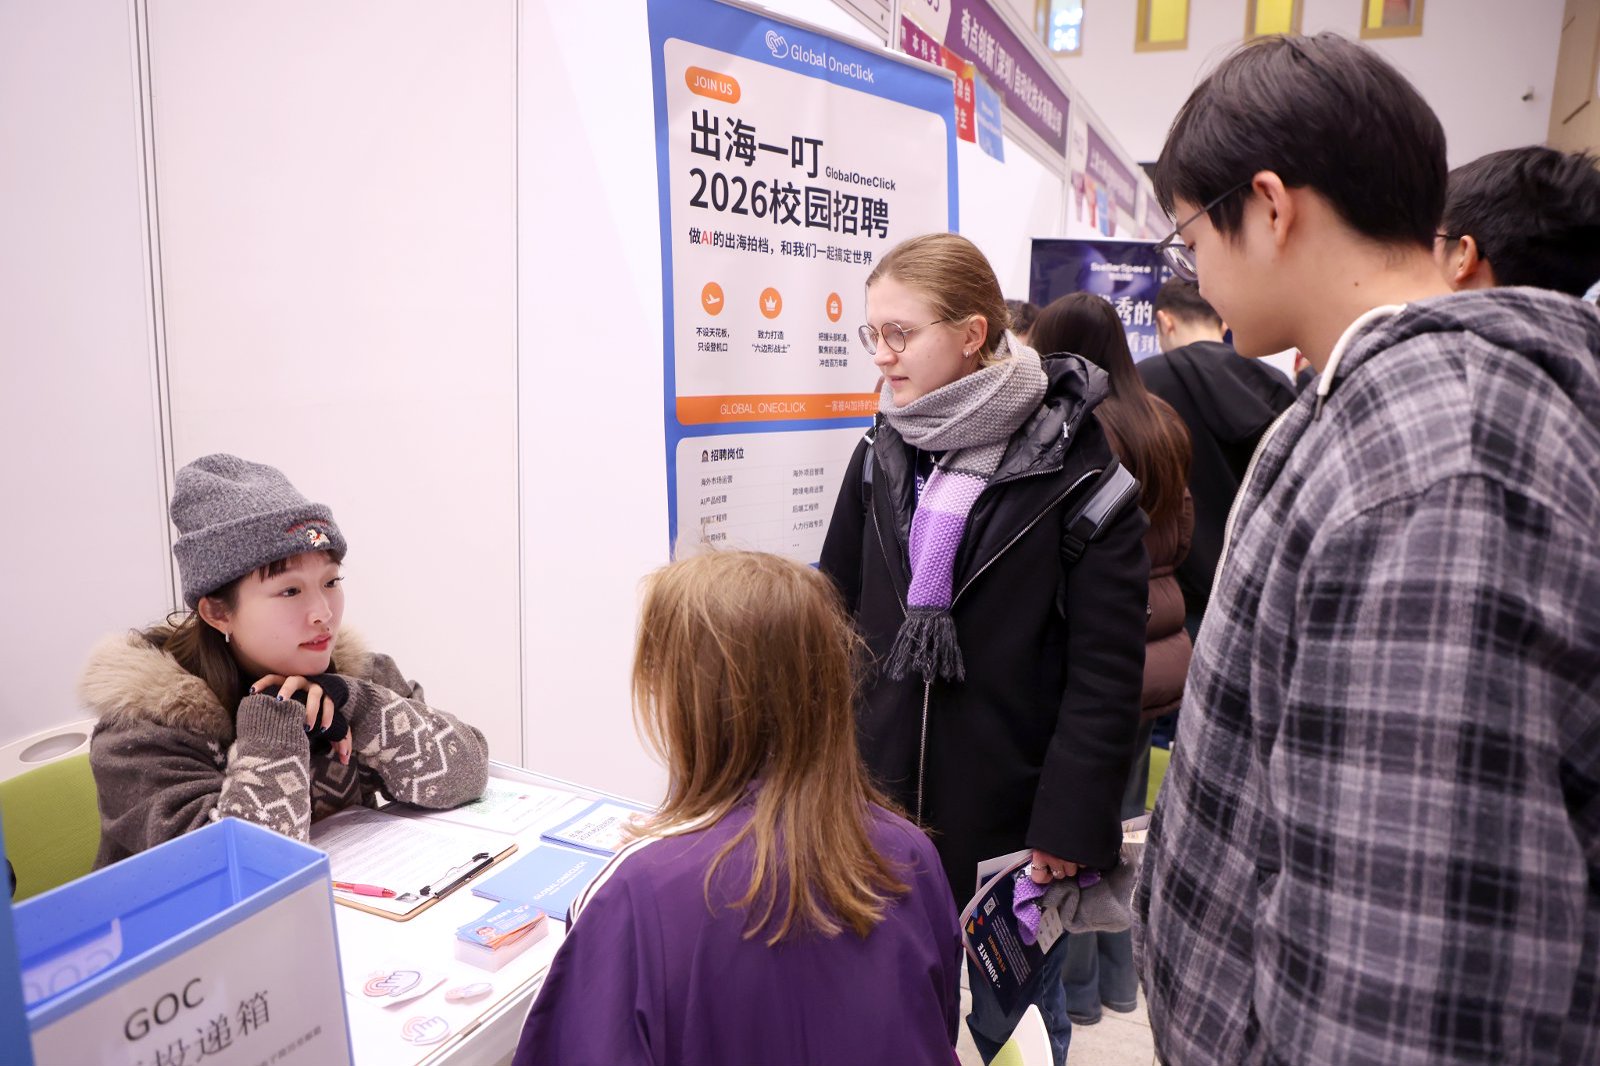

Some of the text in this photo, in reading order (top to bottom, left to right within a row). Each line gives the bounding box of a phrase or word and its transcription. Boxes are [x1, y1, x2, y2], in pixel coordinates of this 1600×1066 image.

[790, 45, 875, 84] Global OneClick
[693, 75, 733, 95] JOIN US
[690, 109, 824, 179] 出海一叮
[825, 166, 896, 191] GlobalOneClick
[689, 168, 889, 239] 2026校园招聘
[697, 341, 728, 352] 只设登机口
[757, 329, 784, 340] 致力打造
[720, 401, 806, 416] GLOBAL ONECLICK
[710, 447, 744, 462] 招聘岗位
[977, 942, 997, 984] SUNRATE
[124, 978, 204, 1042] GOC
